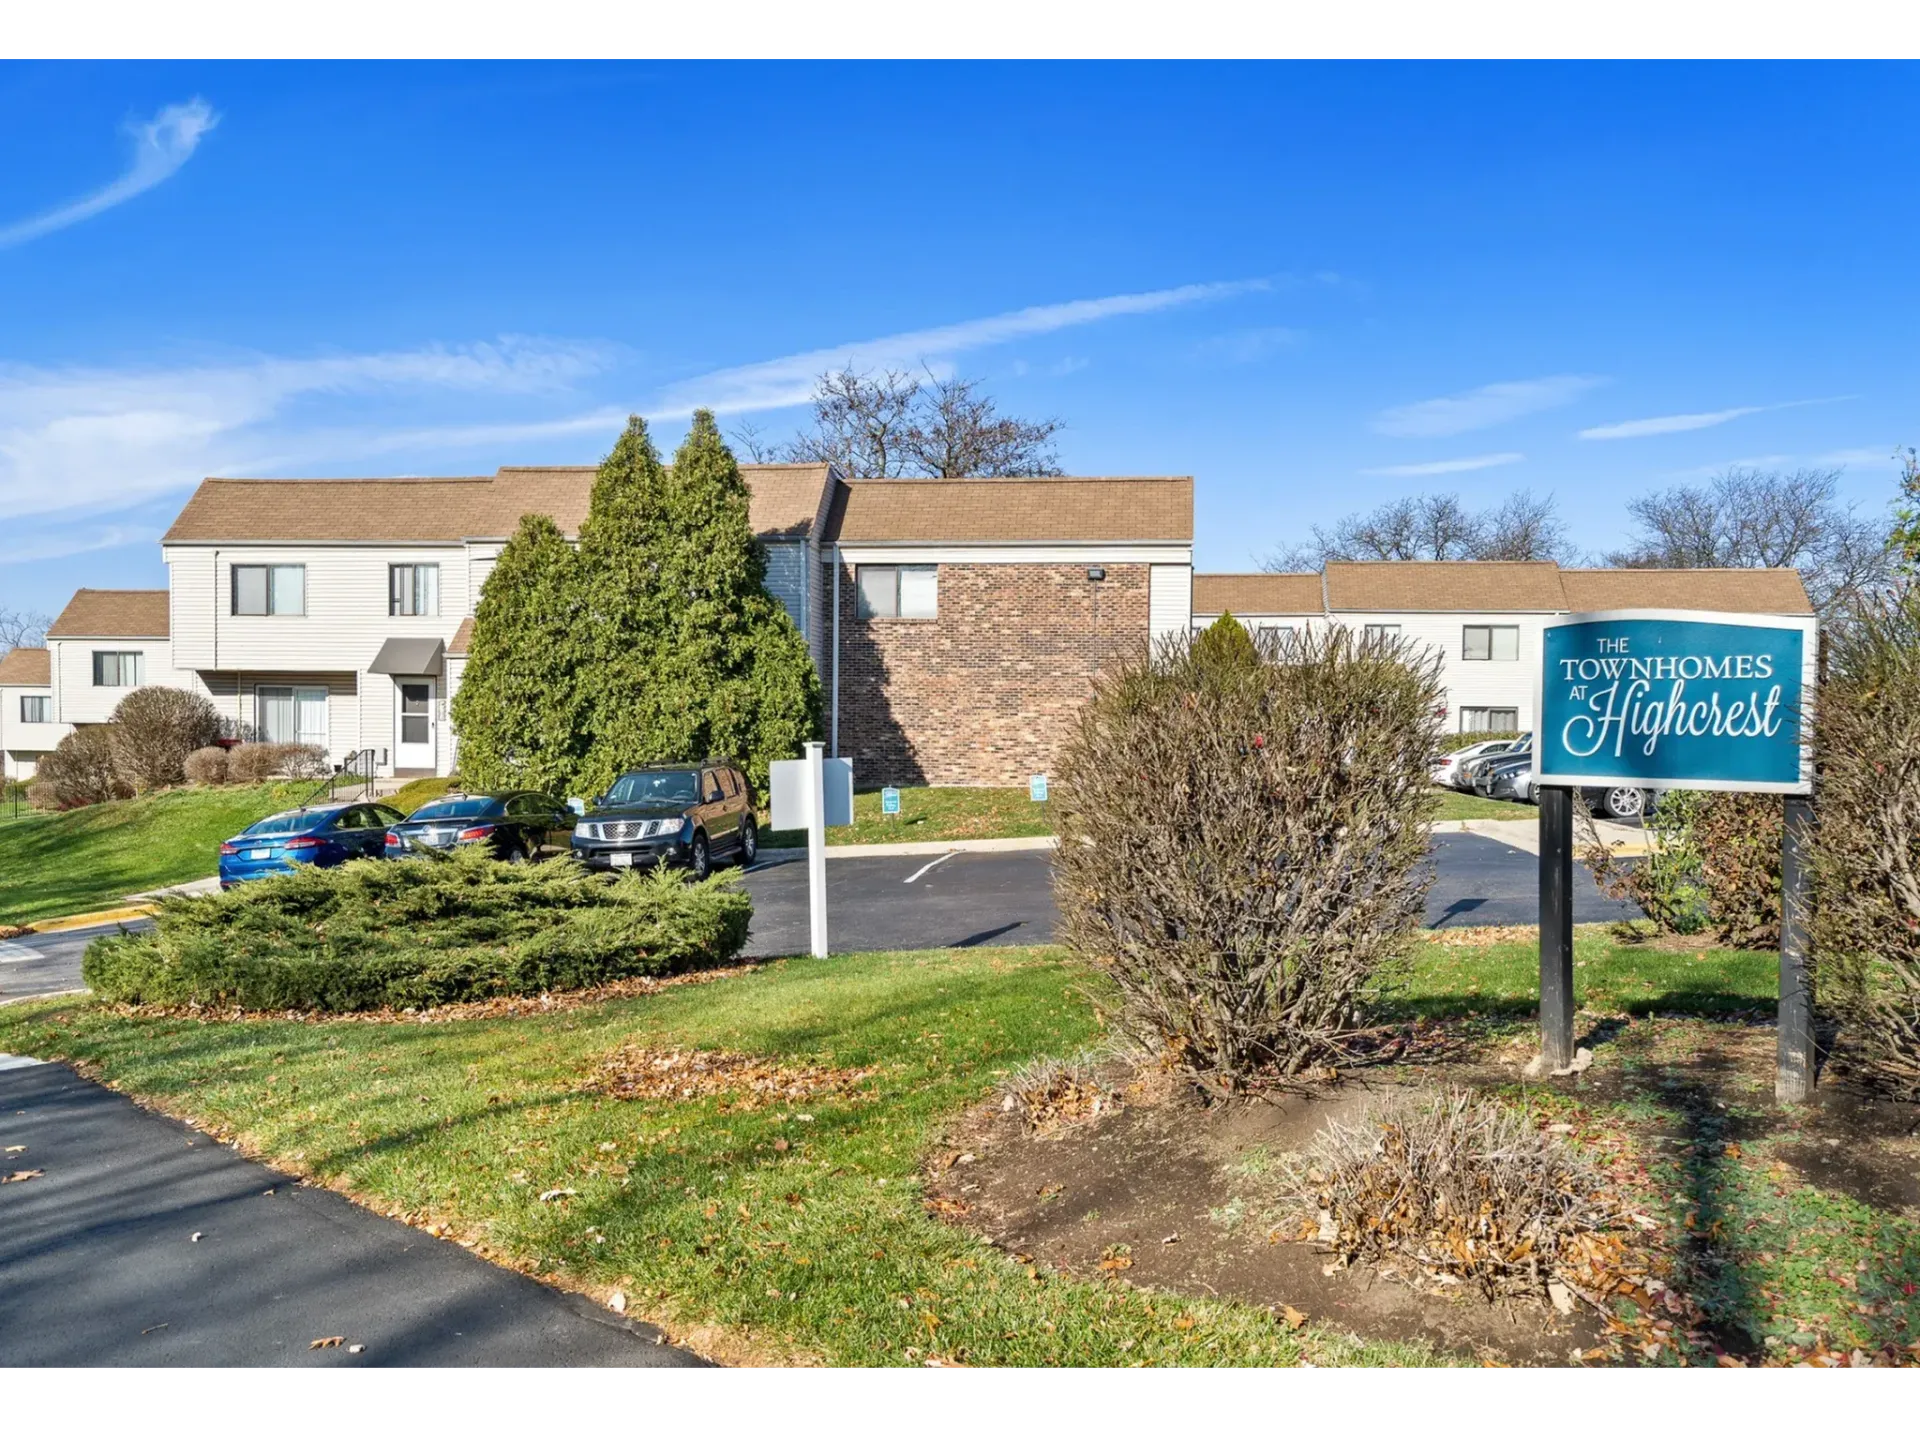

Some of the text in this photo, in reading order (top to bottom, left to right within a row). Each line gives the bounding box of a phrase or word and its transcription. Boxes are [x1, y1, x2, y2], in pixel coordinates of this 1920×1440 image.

[1597, 637, 1630, 654] THE
[1559, 655, 1773, 681] TOWNHOMES
[1562, 679, 1782, 757] AT Highcrest
